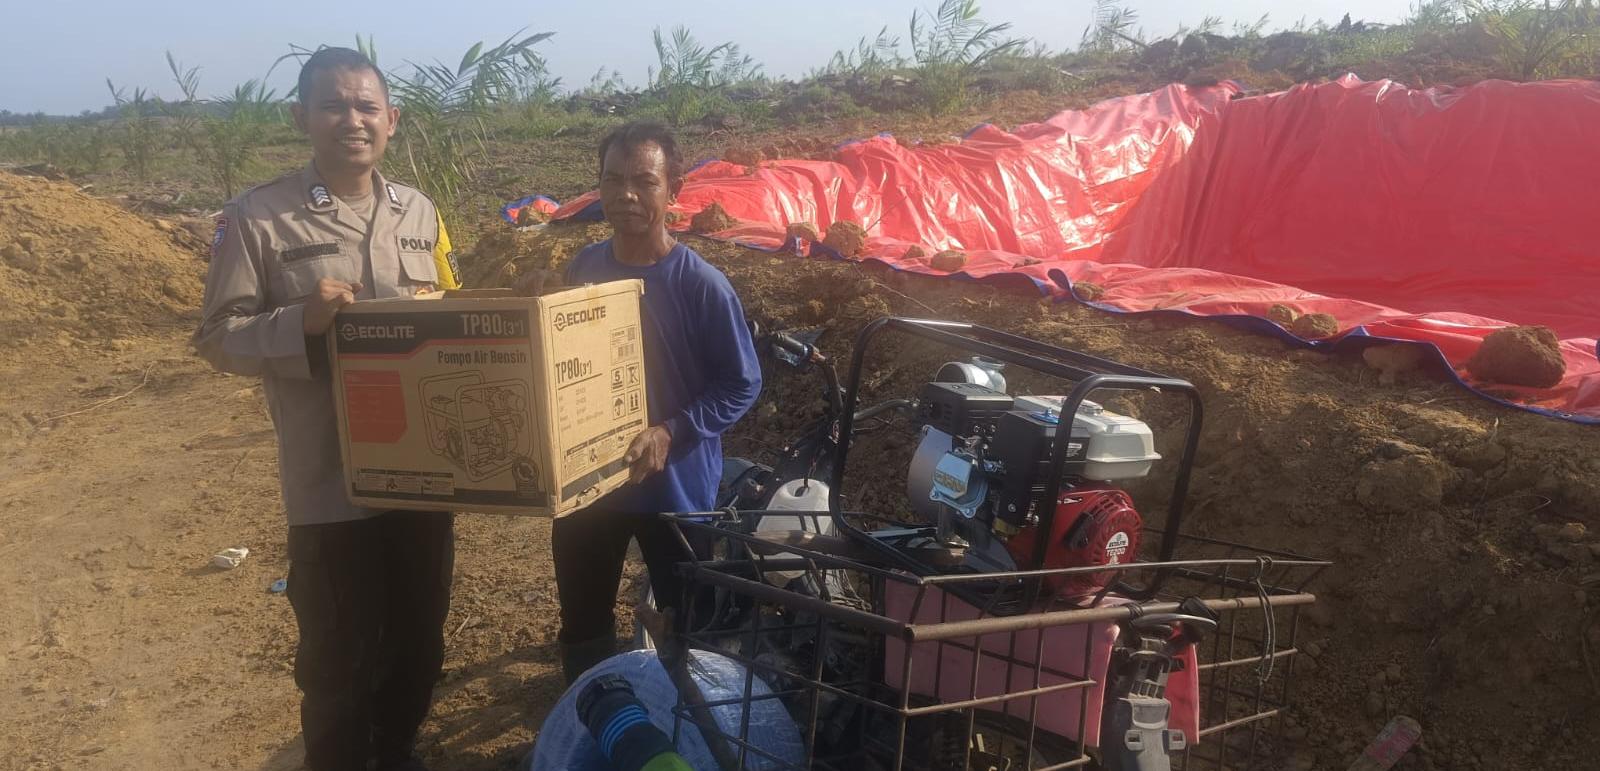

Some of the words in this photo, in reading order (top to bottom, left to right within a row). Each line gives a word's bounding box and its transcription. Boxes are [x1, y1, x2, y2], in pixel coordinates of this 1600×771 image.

[567, 306, 606, 326] ECOLITE
[359, 326, 415, 340] ECOLITE
[438, 351, 471, 367] Pompa
[474, 350, 487, 364] Air
[490, 350, 527, 364] Bensin
[614, 371, 621, 381] 5
